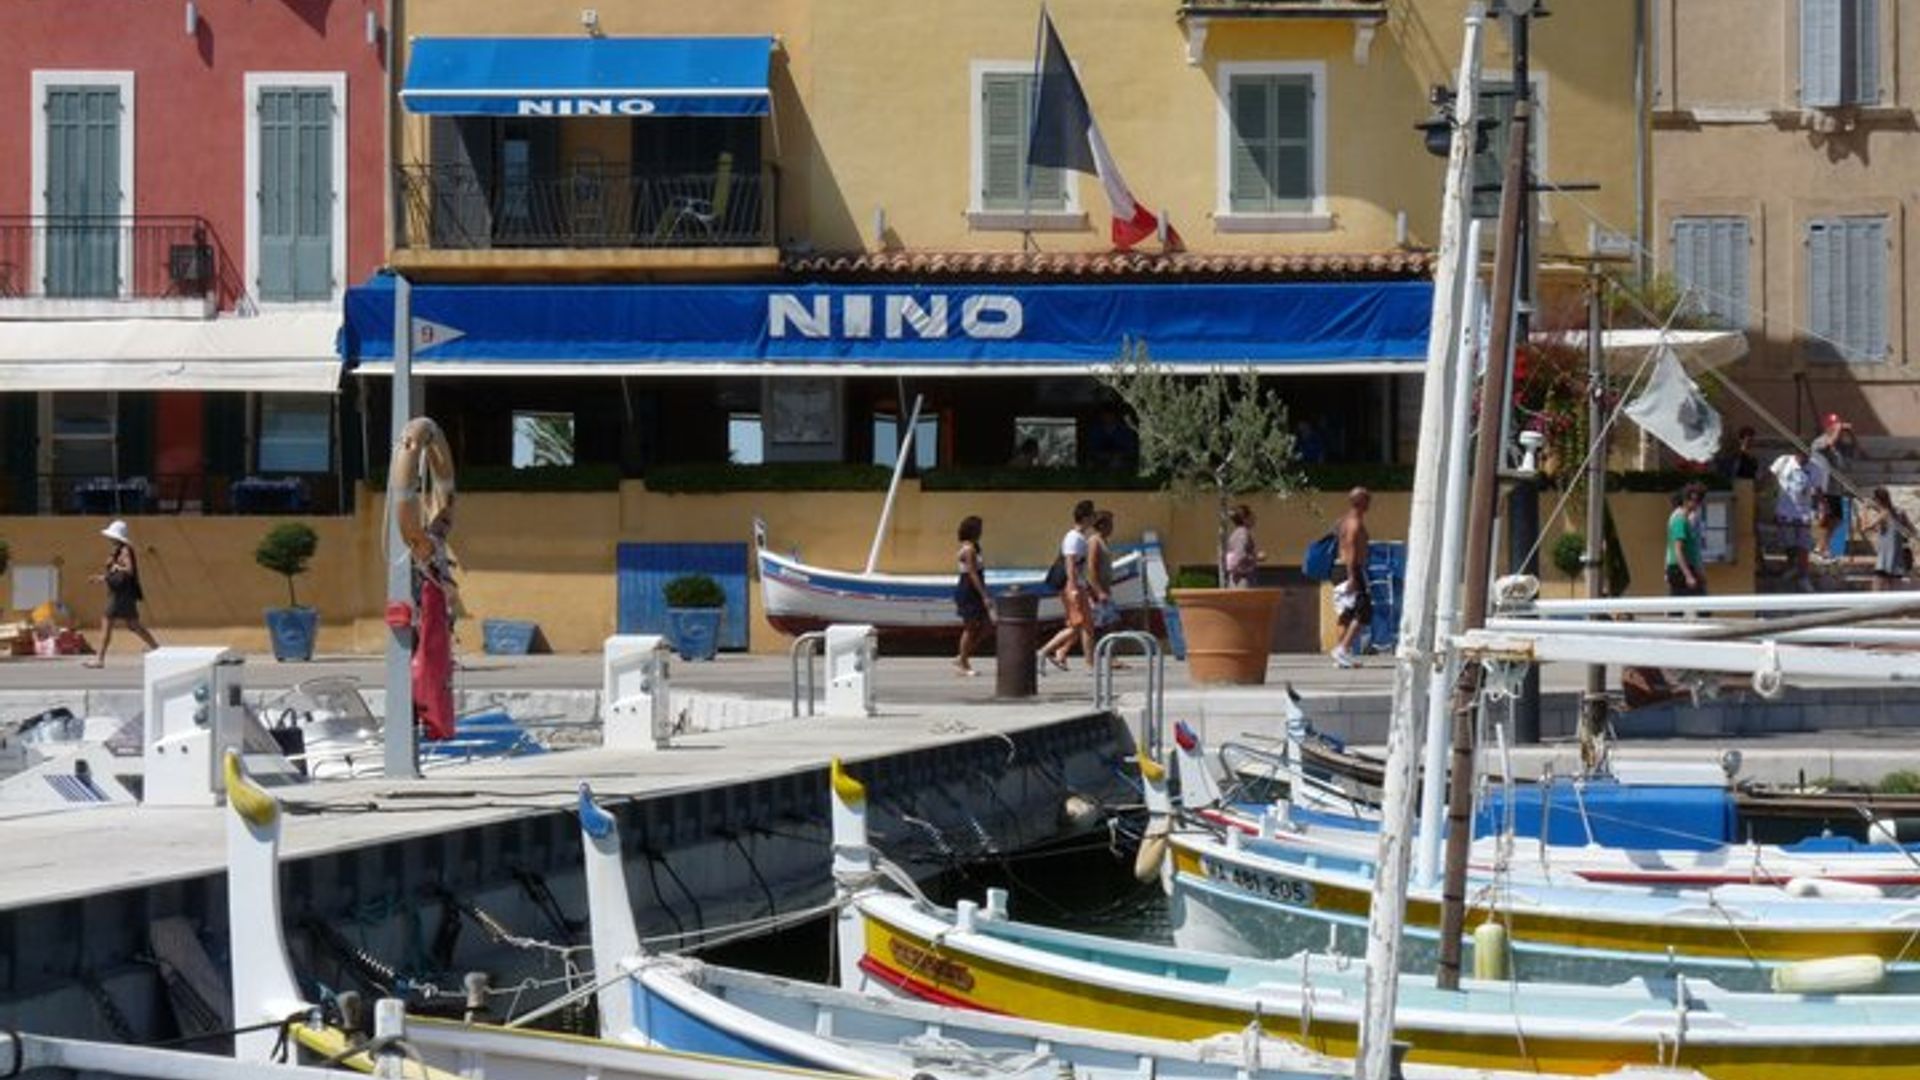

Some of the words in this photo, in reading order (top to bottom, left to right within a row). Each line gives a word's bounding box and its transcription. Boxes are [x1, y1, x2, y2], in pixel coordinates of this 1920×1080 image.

[518, 99, 655, 115] NINO
[768, 294, 1023, 338] NINO
[421, 325, 433, 343] 9
[1265, 875, 1306, 902] 205
